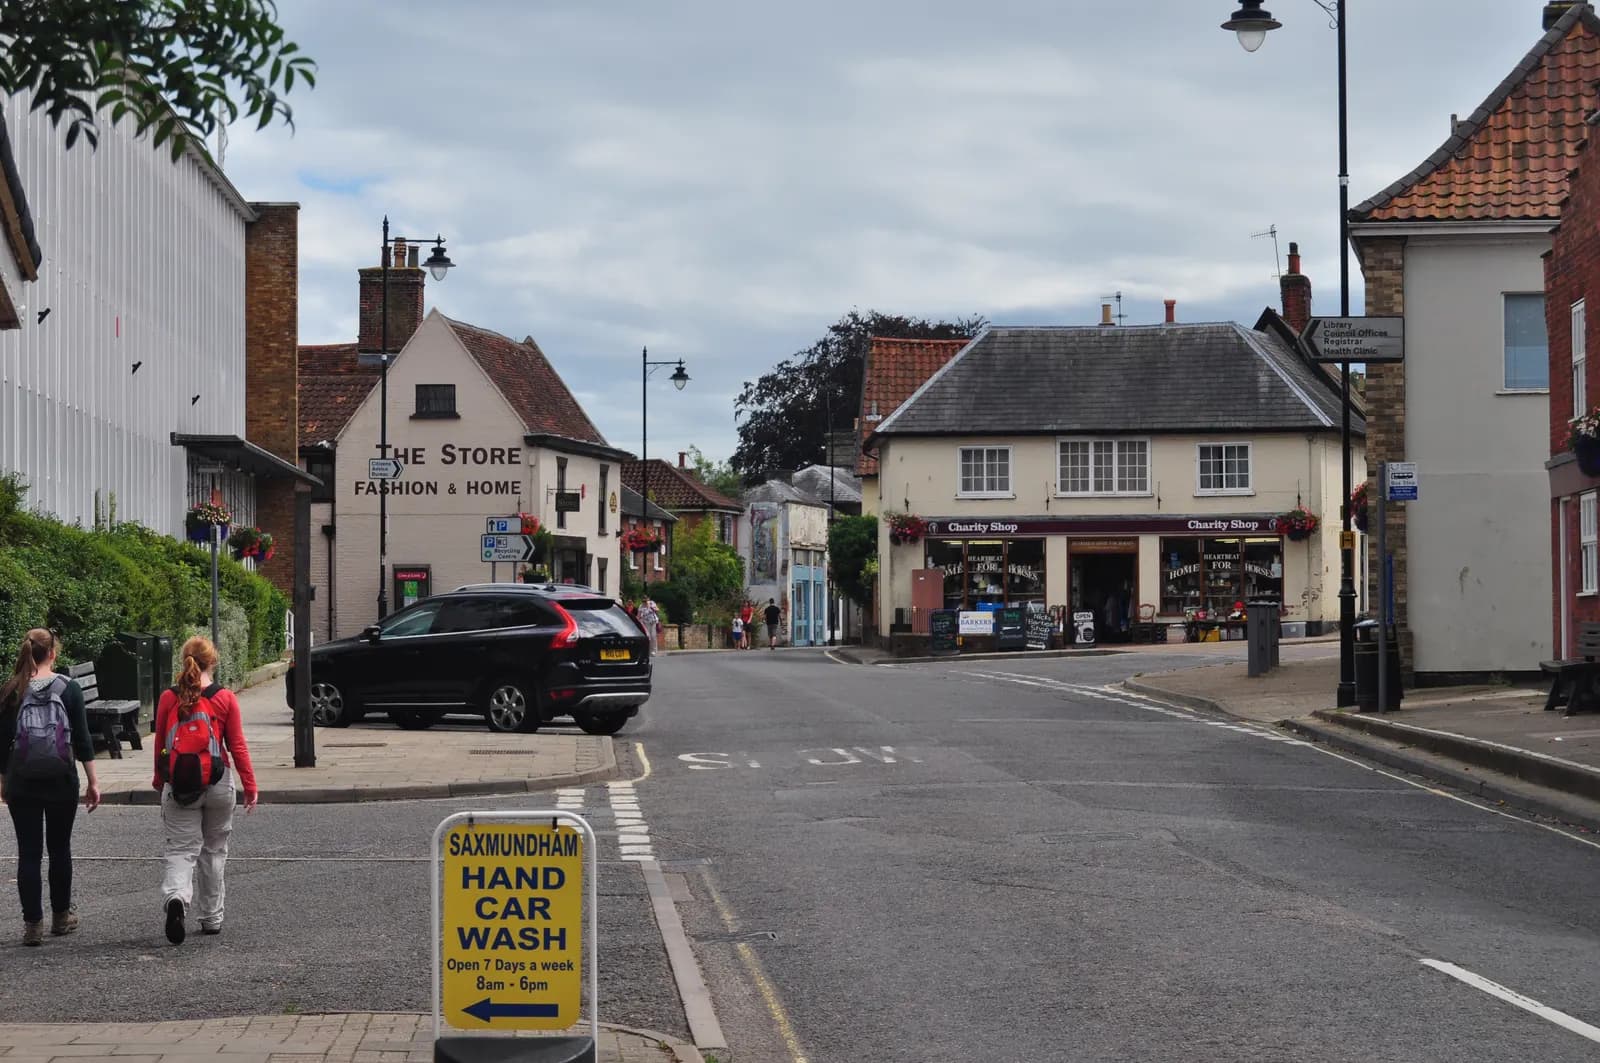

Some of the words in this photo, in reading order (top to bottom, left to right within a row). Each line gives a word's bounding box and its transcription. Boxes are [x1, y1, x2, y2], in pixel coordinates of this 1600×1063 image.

[1323, 321, 1353, 330] Library
[1323, 330, 1356, 338] Council
[1357, 329, 1388, 338] Offices
[1323, 338, 1363, 346] Registrar
[1323, 347, 1352, 355] Health
[1353, 347, 1379, 355] Clinic
[441, 443, 522, 465] STORE
[354, 481, 438, 495] FASHION
[447, 482, 457, 495] &
[466, 481, 522, 495] HOME
[948, 522, 989, 533] Charity
[990, 522, 1018, 533] Shop
[1187, 520, 1229, 531] Charity
[1230, 520, 1259, 531] Shop
[1169, 563, 1199, 580] HOME
[1212, 561, 1232, 570] FOR
[450, 833, 578, 857] SAXMUNDHAM
[462, 866, 566, 890] HAND
[475, 896, 552, 920] CAR
[457, 927, 566, 951] WASH
[447, 959, 480, 973] Open
[484, 959, 492, 971] 7
[495, 959, 526, 973] Days
[529, 962, 537, 971] a
[541, 959, 574, 971] week
[476, 976, 505, 991] 8am
[519, 976, 548, 993] 6pm
